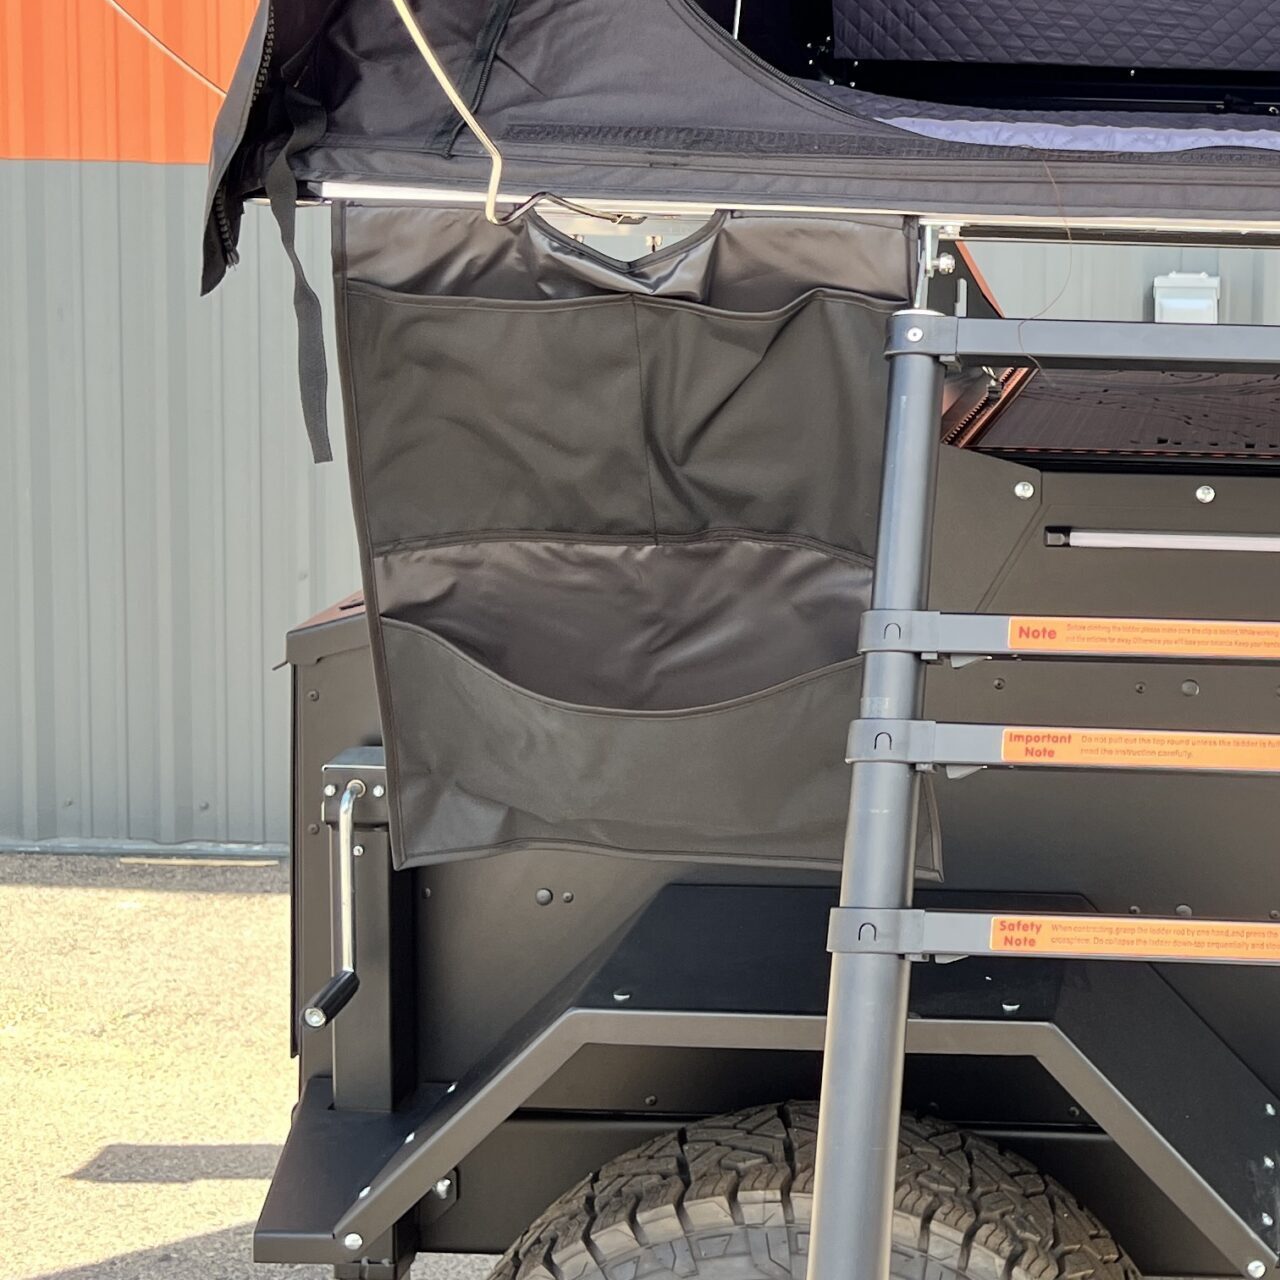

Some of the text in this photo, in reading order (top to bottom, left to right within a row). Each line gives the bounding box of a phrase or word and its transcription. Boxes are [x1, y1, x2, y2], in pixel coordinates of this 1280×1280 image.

[1018, 625, 1057, 639] Note
[1009, 732, 1072, 745] Important
[1024, 746, 1055, 758] Note
[999, 920, 1042, 935] Safety
[1003, 935, 1036, 947] Note
